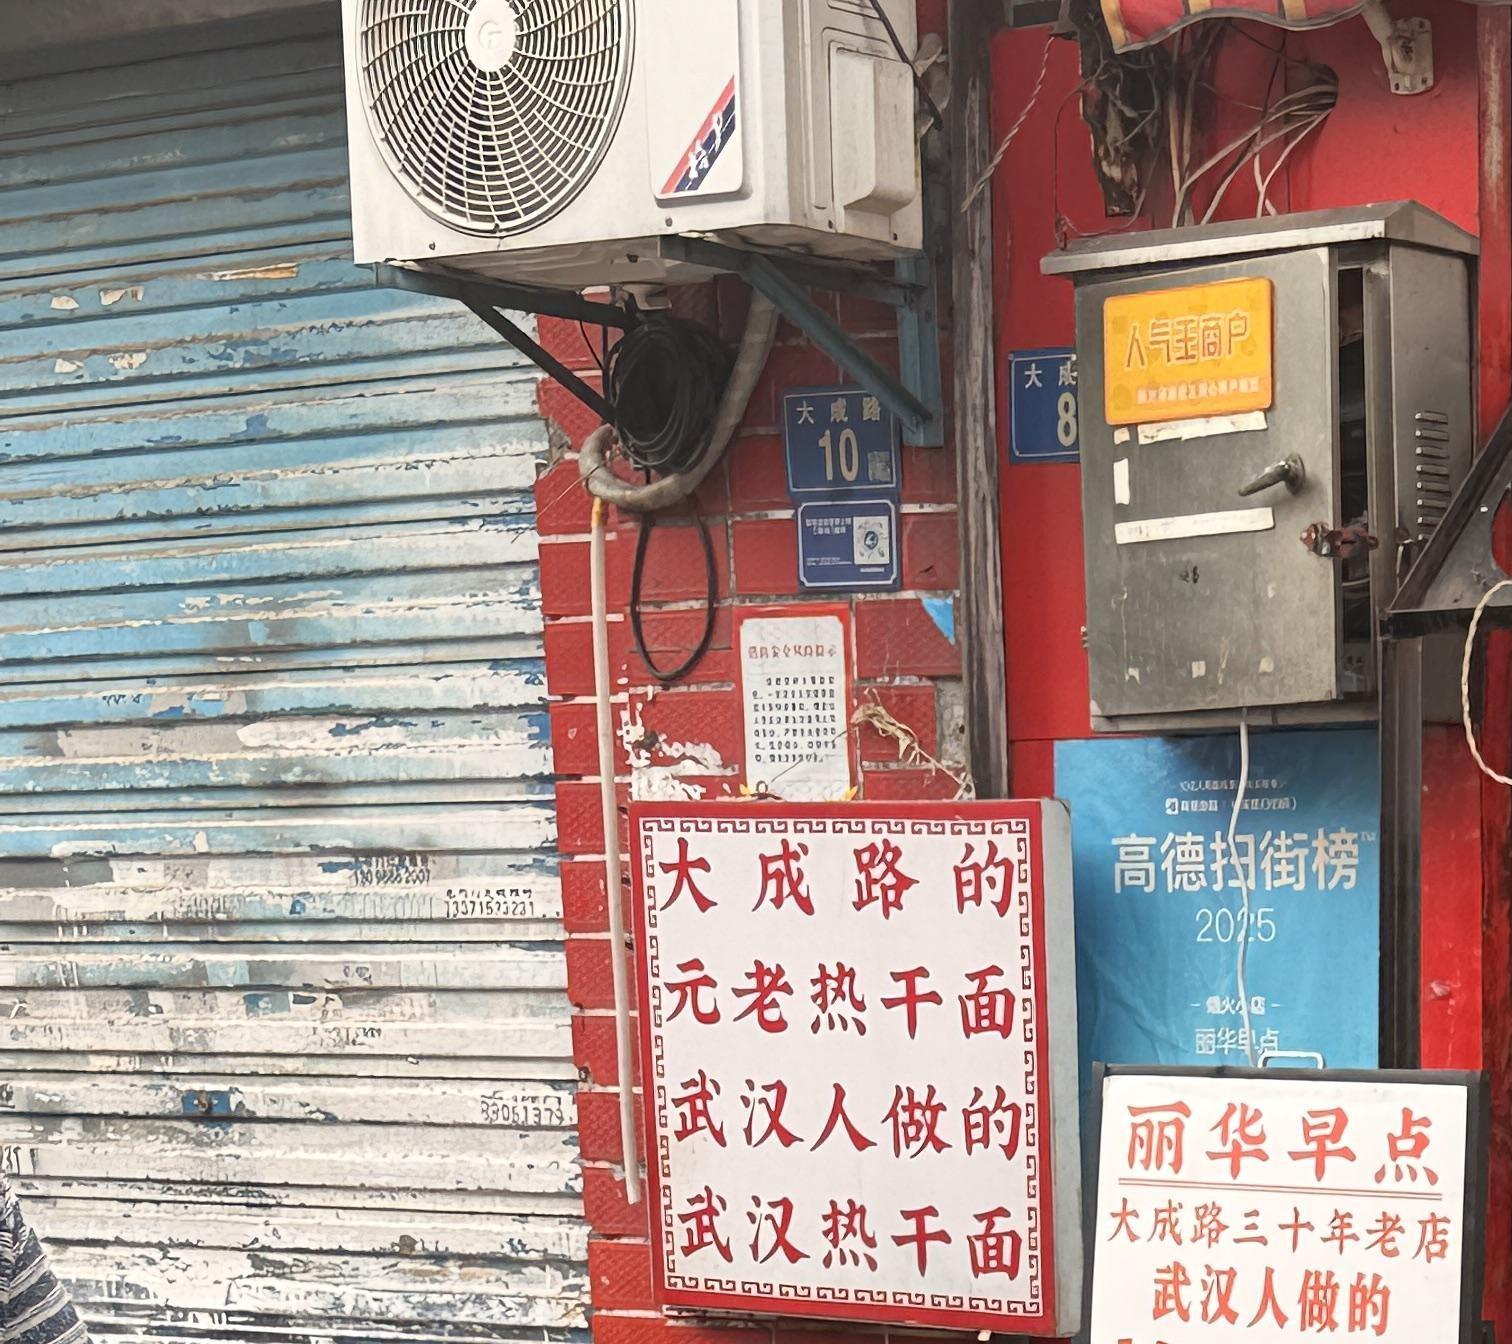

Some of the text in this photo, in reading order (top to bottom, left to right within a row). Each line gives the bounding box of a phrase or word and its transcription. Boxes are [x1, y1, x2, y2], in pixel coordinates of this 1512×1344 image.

[796, 396, 881, 425] 大成路
[818, 428, 860, 482] 10
[658, 836, 1015, 920] 大成路的
[1111, 827, 1360, 893] 高德扫街榜
[663, 957, 1016, 1040] 元老热干面
[671, 1068, 1023, 1161] 武汉人做的
[1126, 1100, 1441, 1186] 丽华早点
[677, 1185, 1023, 1281] 武汉热干面
[1107, 1197, 1452, 1264] 大成路三十年老店
[1152, 1260, 1391, 1337] 武汉人做的
